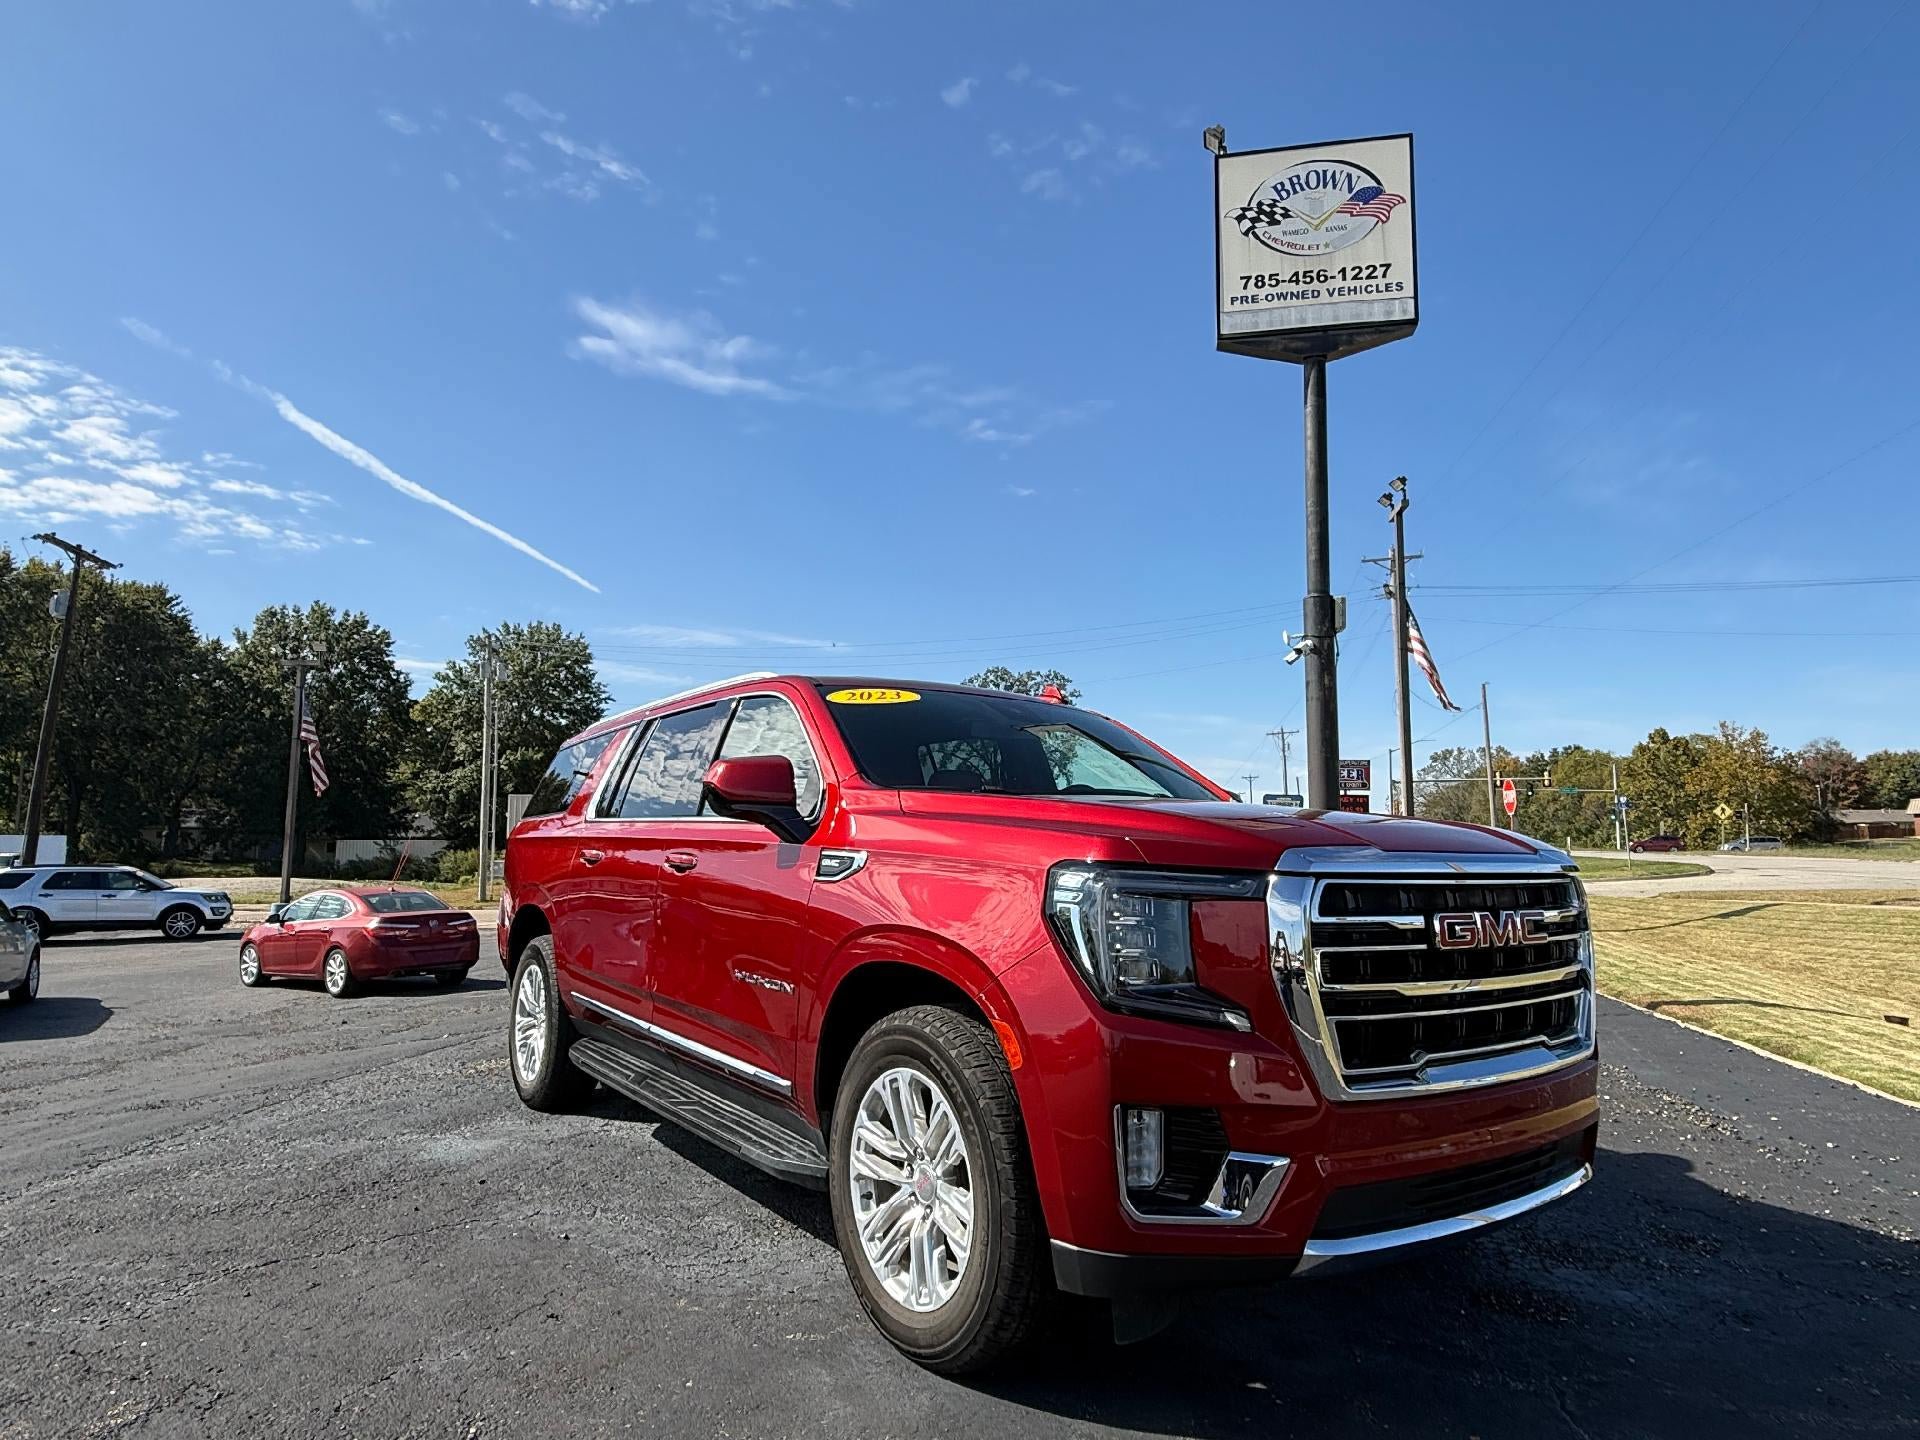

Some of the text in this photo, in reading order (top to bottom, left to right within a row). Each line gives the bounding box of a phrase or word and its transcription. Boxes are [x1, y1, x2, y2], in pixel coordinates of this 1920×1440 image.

[1271, 169, 1360, 202] BROWN
[1325, 224, 1348, 232] KANSAS
[1262, 231, 1320, 250] CHEVROLET
[1240, 263, 1392, 290] 785-456-1227
[1230, 282, 1404, 305] PRE-OWNED VEHICLES
[847, 691, 901, 701] 2023
[1340, 769, 1364, 781] EER
[1438, 910, 1549, 949] GMC
